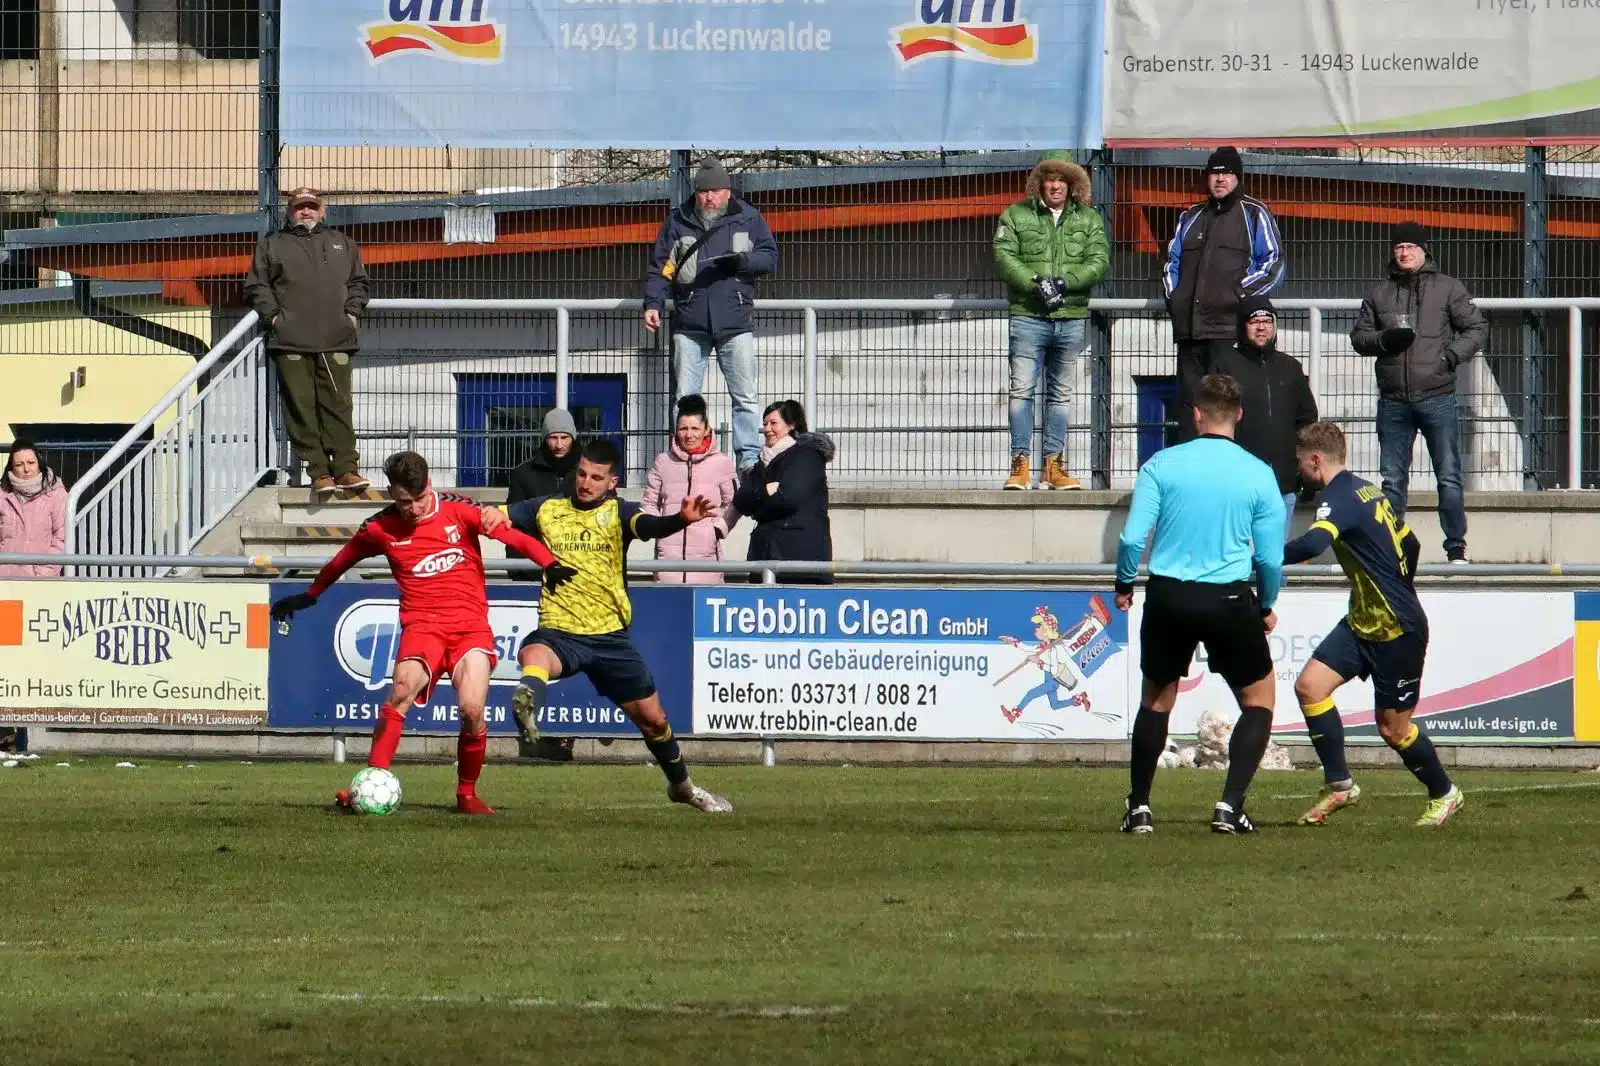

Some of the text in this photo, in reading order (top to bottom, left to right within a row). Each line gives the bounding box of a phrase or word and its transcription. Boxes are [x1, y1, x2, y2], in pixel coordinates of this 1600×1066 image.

[560, 21, 831, 51] 14943 Luckenwalde
[1123, 55, 1215, 72] Grabenstr.
[1221, 54, 1272, 71] 30-31
[1300, 54, 1354, 71] 14943
[1361, 52, 1479, 71] Luckenwalde
[62, 591, 207, 650] SANITÄTSHAUS
[706, 598, 989, 637] Trebbin Clean GmbH
[94, 625, 173, 666] BEHR
[707, 648, 989, 676] Glas- und Gebäudereinigung
[0, 678, 266, 702] Ein Haus für Ihre Gesundheit.
[708, 682, 784, 704] Telefon:
[791, 683, 857, 705] 033731
[876, 684, 910, 706] 808
[916, 685, 938, 706] 21
[100, 712, 159, 724] Gartenstraße
[176, 713, 204, 724] 14943
[433, 705, 506, 722] MEEN
[707, 710, 918, 733] www.trebbin-clean.de
[1425, 716, 1558, 733] www.luk-design.de
